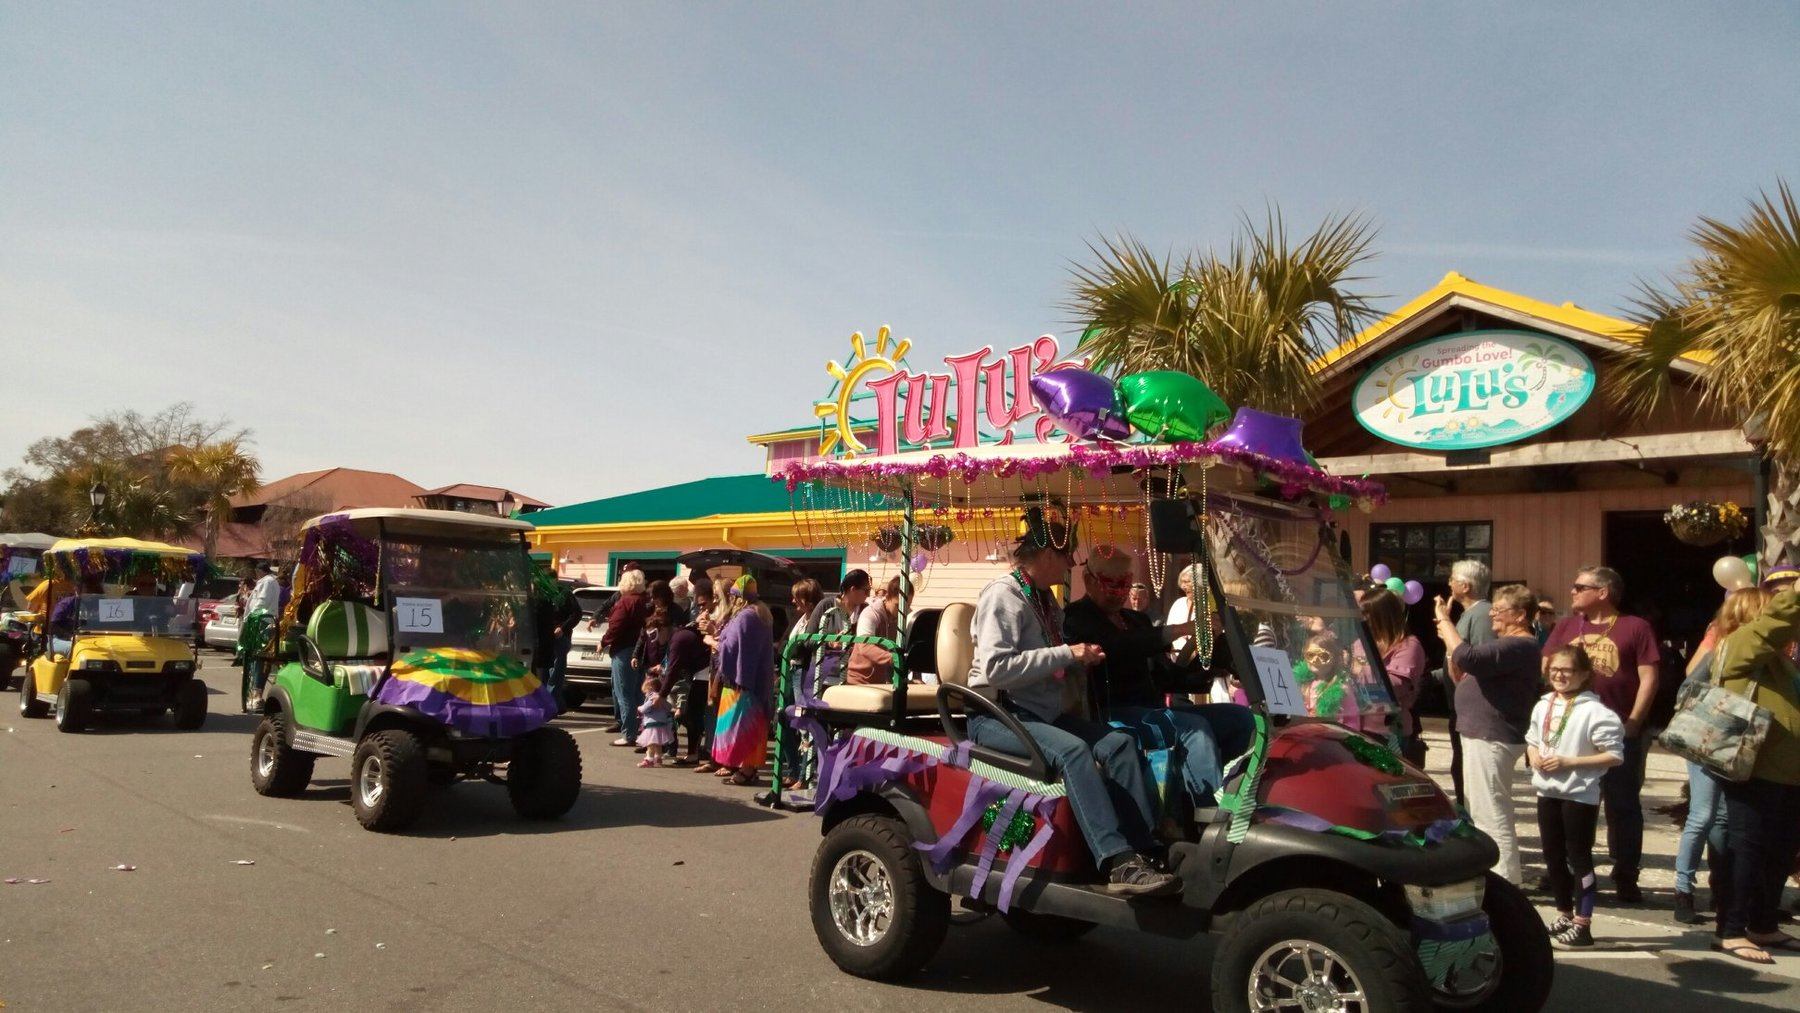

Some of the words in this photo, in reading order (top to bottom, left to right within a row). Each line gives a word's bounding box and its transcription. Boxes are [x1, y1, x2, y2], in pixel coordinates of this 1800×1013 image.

[1482, 340, 1496, 349] the
[1422, 354, 1472, 369] Gumbo
[1476, 347, 1513, 363] Love!
[1407, 363, 1530, 419] LuLu's
[106, 604, 125, 618] 16
[405, 607, 432, 627] 15
[1267, 666, 1292, 706] 14
